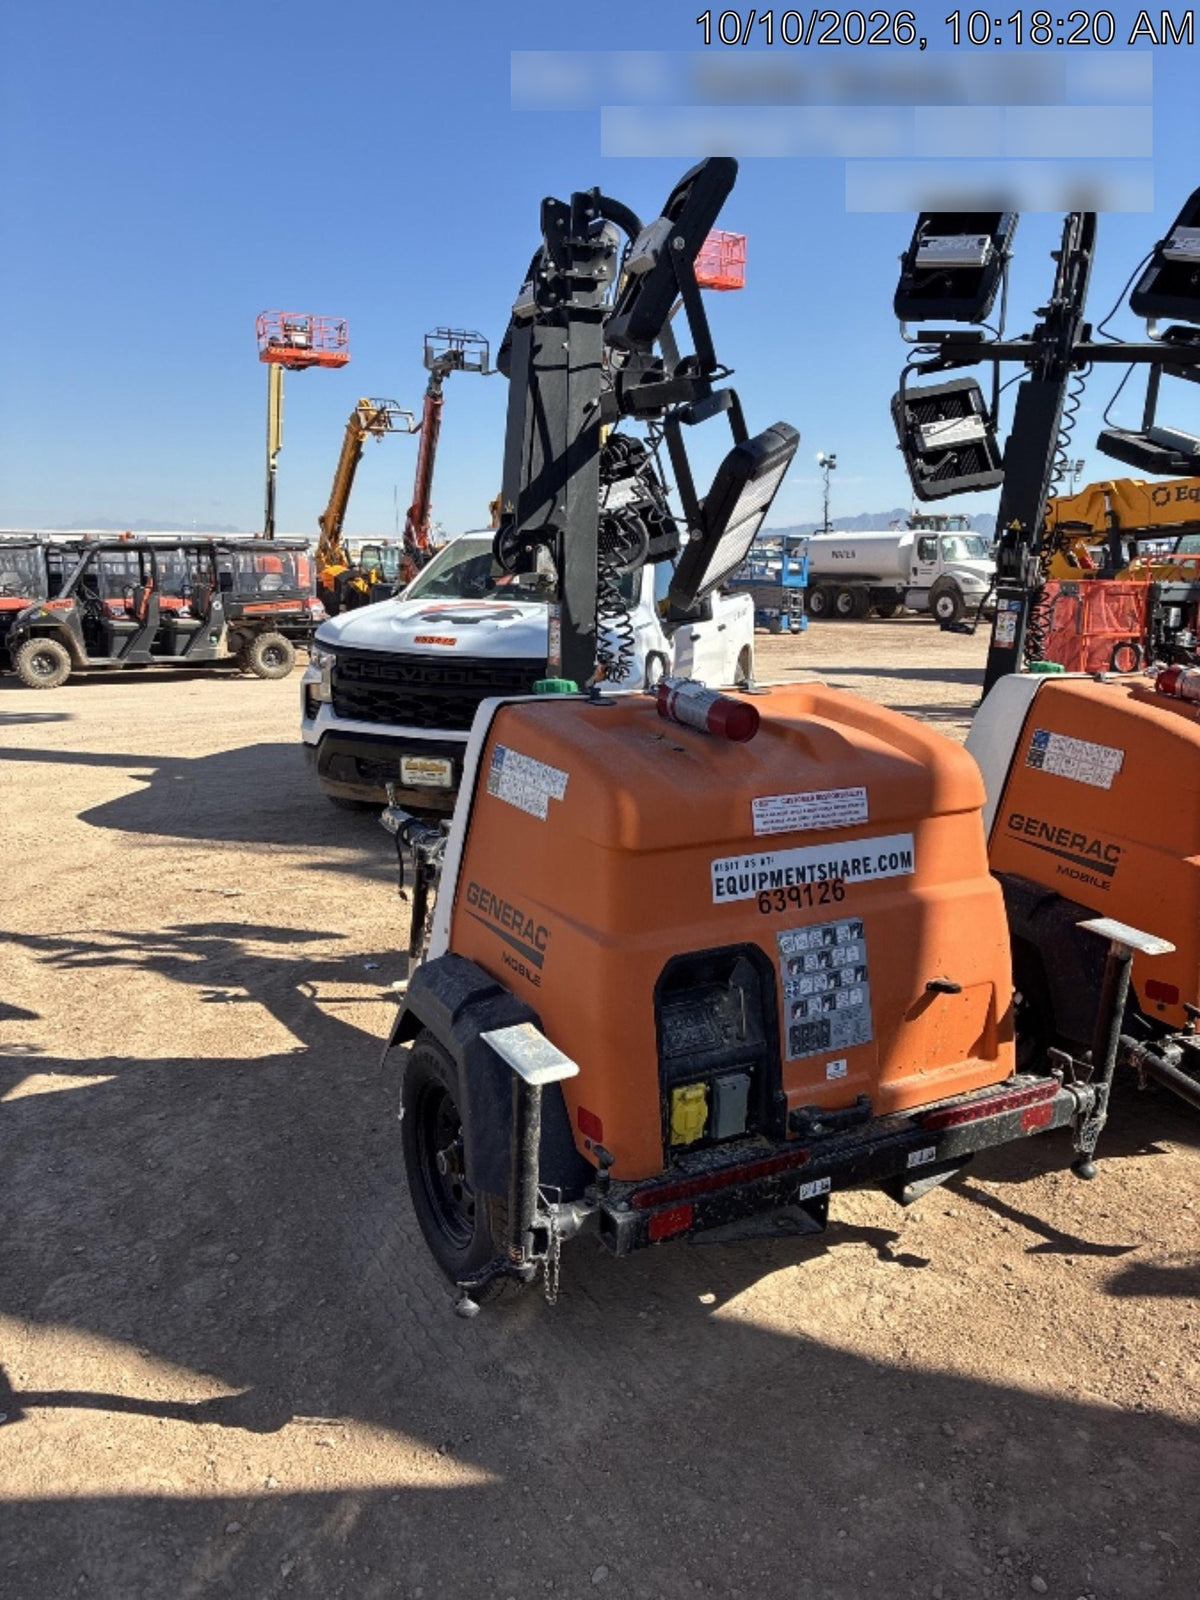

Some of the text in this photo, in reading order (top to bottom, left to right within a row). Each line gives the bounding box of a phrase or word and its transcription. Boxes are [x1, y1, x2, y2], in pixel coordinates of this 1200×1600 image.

[1008, 813, 1121, 864] GENERAC
[716, 851, 912, 897] EQUIPMENTSHARE.COM
[1056, 865, 1111, 891] MOBILE
[467, 881, 549, 951] GENERAC
[758, 880, 846, 914] 639126
[501, 951, 542, 987] MOBILE
